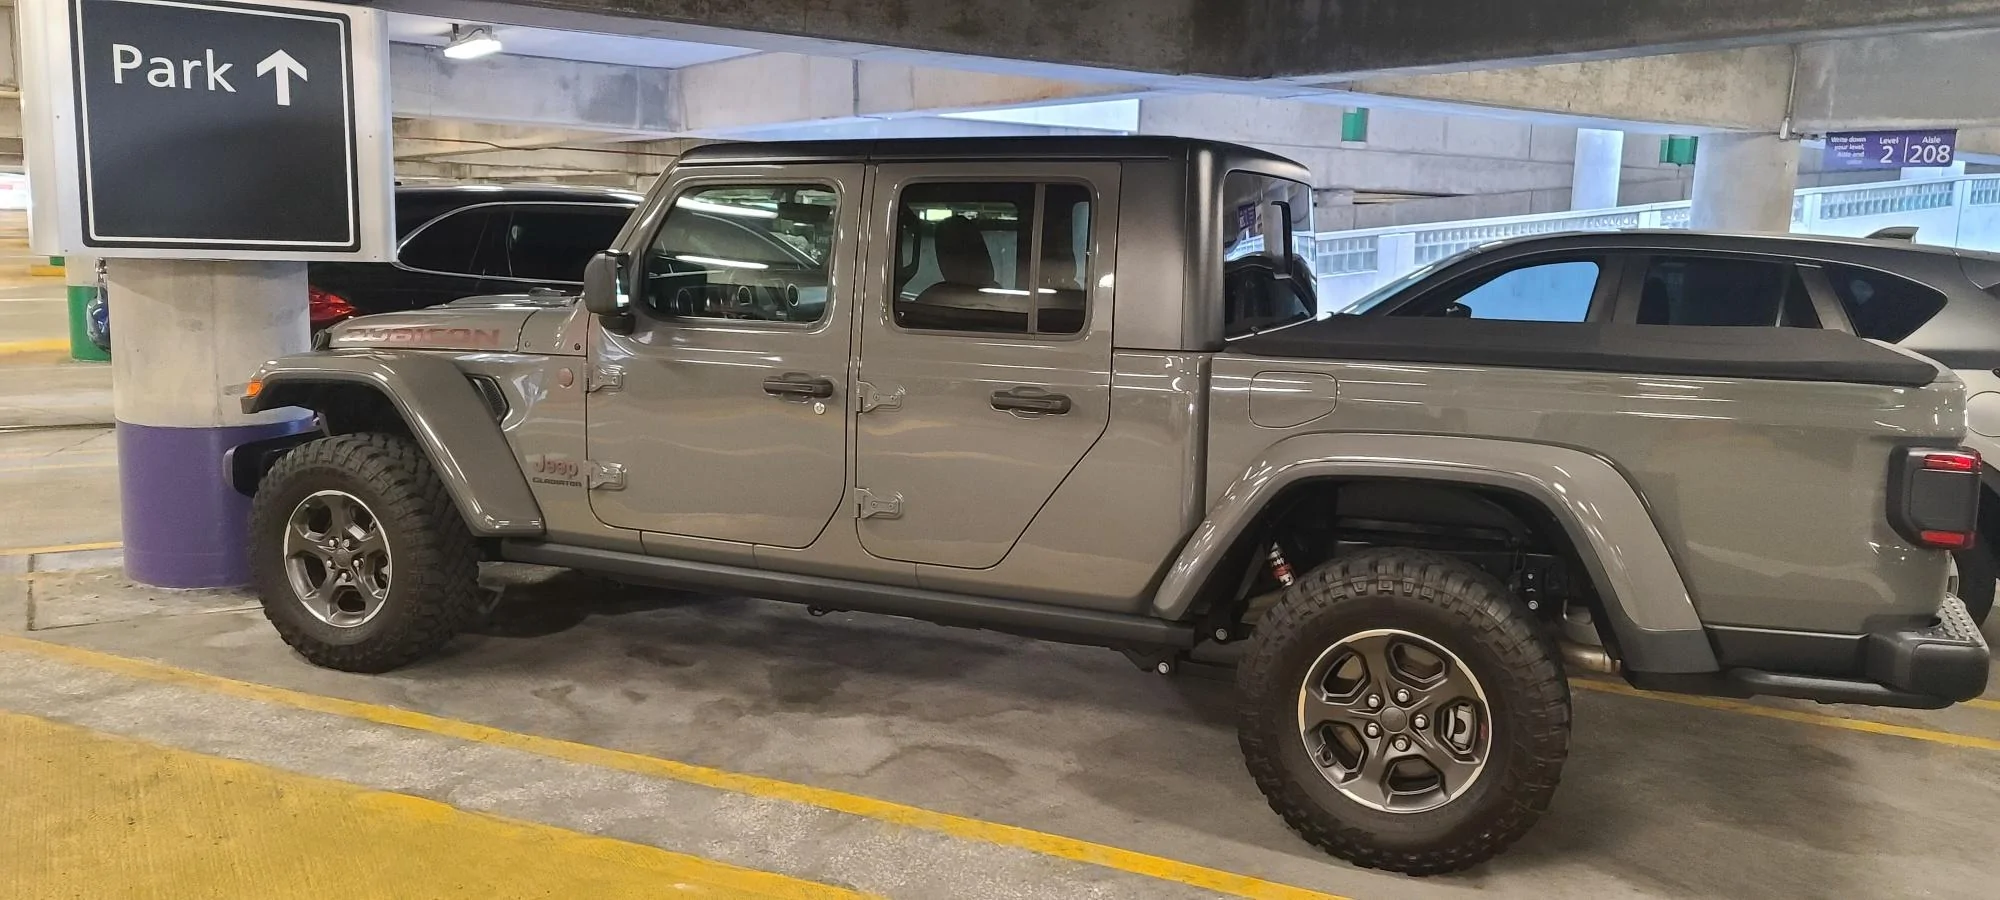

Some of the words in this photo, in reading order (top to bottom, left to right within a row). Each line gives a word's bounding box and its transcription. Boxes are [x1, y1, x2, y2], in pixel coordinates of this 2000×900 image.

[112, 43, 237, 93] Park
[1848, 135, 1867, 143] down
[1879, 136, 1899, 145] Level
[1921, 136, 1942, 145] Aisle
[1879, 147, 1893, 164] 2
[1908, 144, 1951, 164] 208
[535, 454, 579, 479] Jeep
[532, 476, 582, 488] GLADIATOR
